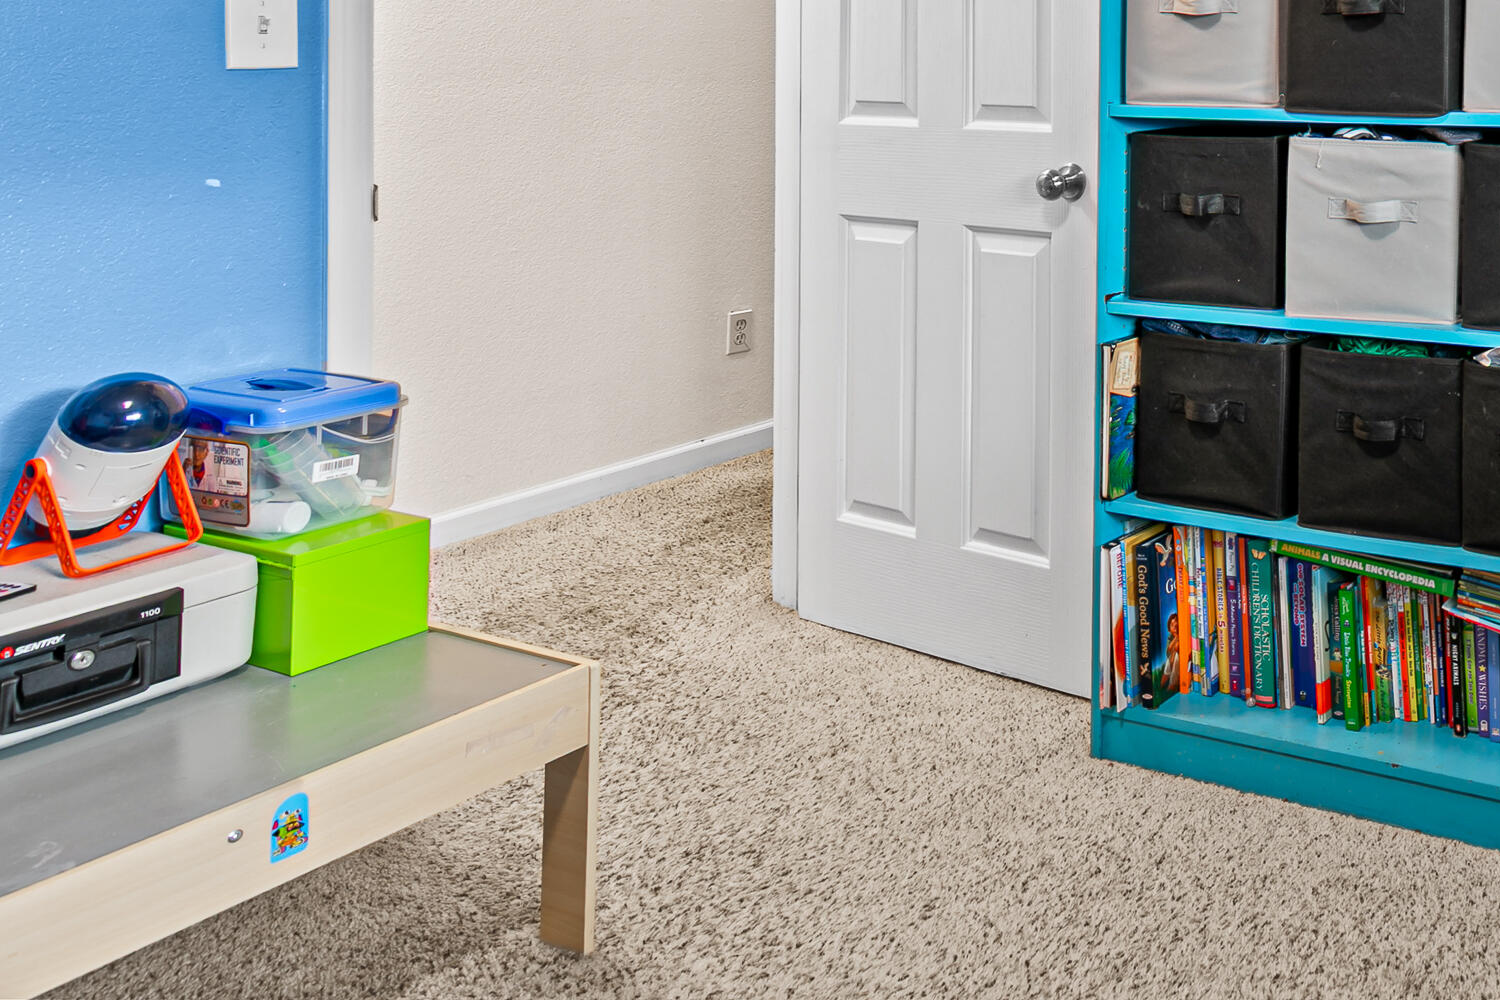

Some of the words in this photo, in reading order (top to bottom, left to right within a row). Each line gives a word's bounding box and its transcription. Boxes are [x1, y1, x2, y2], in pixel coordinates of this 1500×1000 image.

[213, 455, 244, 467] EXPERIMENT
[1281, 543, 1320, 560] ANIMALS
[1137, 565, 1148, 594] God's
[1322, 553, 1329, 562] A
[1331, 555, 1364, 571] VISUAL
[1365, 563, 1436, 588] ENCYCLOPEDIA
[1251, 562, 1262, 624] CHILDREN'S
[140, 607, 161, 619] 1100
[1138, 596, 1150, 626] Good
[1217, 619, 1225, 628] 5
[1260, 593, 1271, 662] SCHOLASTIC
[1299, 613, 1307, 647] SYSTEM
[14, 633, 66, 656] SENTRY
[1140, 628, 1151, 658] News
[1253, 625, 1263, 690] DICTIONARY
[1477, 626, 1485, 664] RANDMA
[1479, 674, 1488, 711] WISHES
